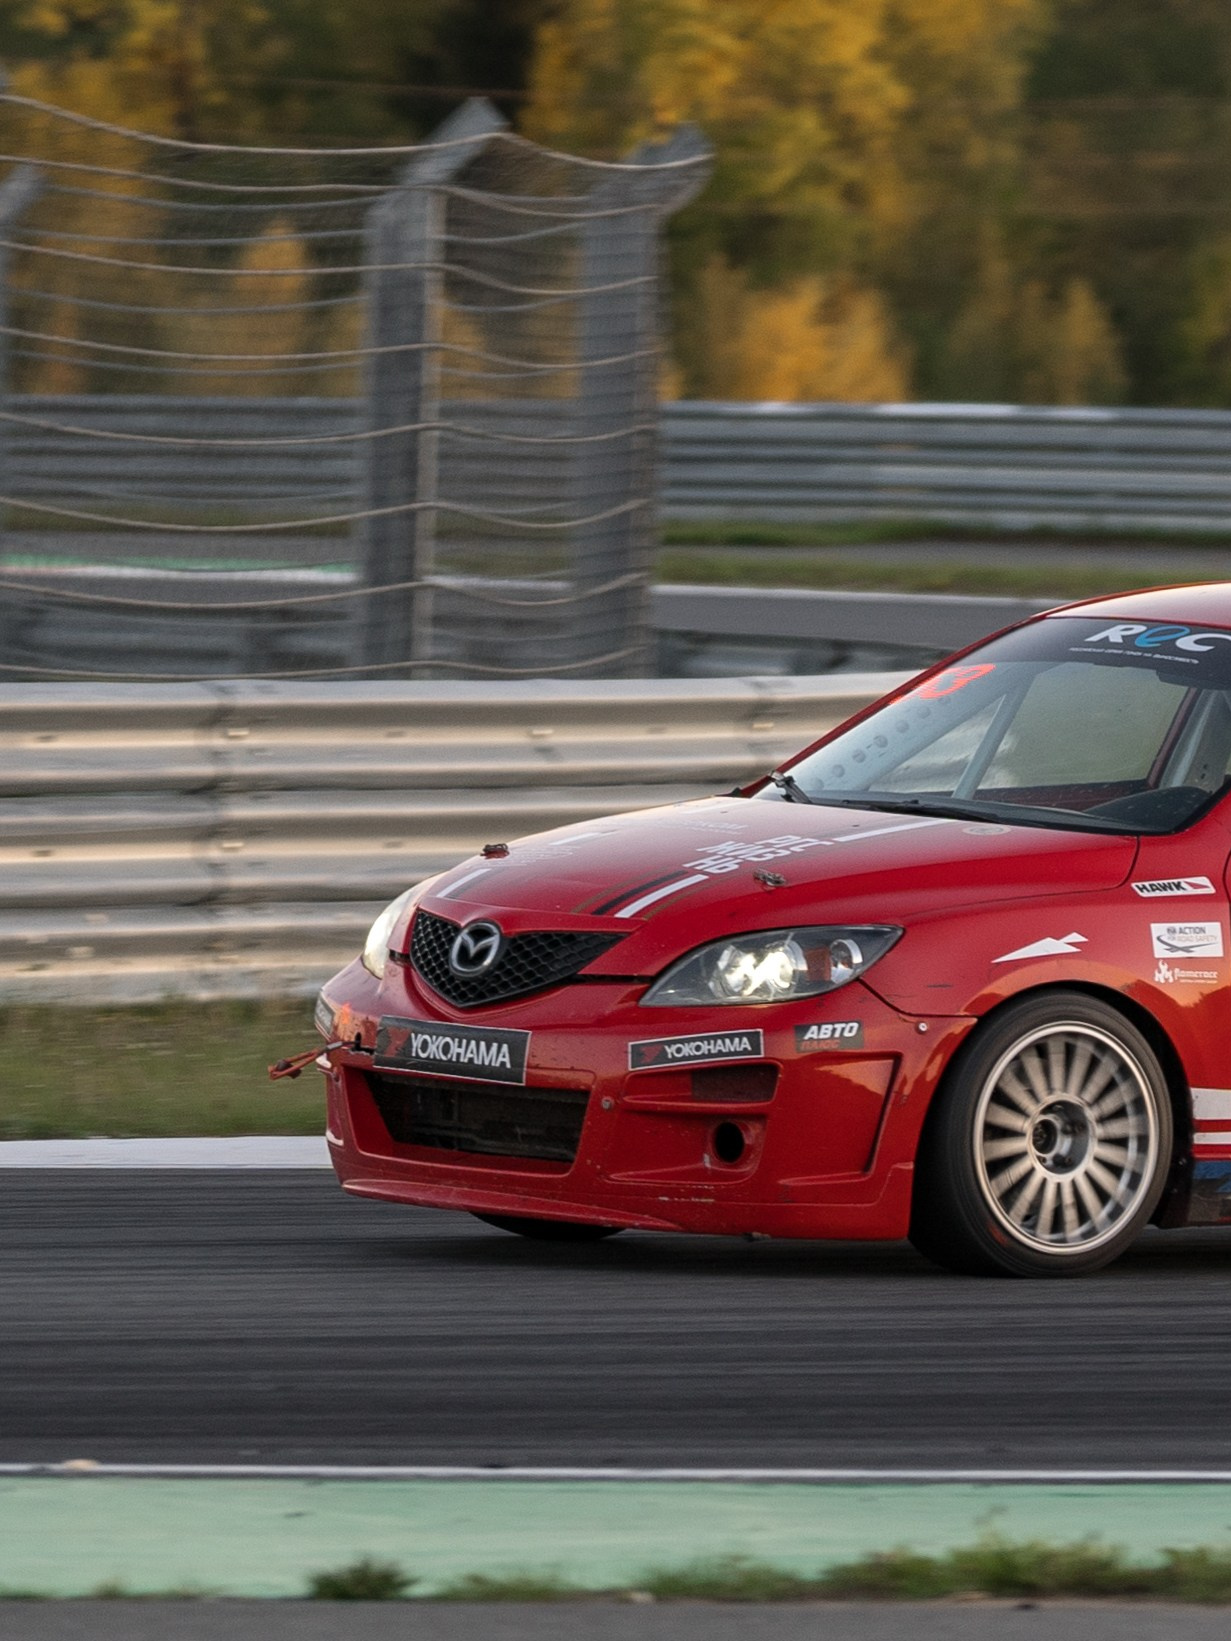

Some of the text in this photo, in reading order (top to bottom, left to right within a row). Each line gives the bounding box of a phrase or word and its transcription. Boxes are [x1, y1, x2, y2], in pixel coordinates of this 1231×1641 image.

[1135, 881, 1187, 893] HAWK
[1179, 926, 1206, 934] ACTION
[803, 1022, 859, 1040] АВТО
[409, 1032, 511, 1069] YOKOHAMA
[663, 1036, 752, 1060] YOKOHAMA
